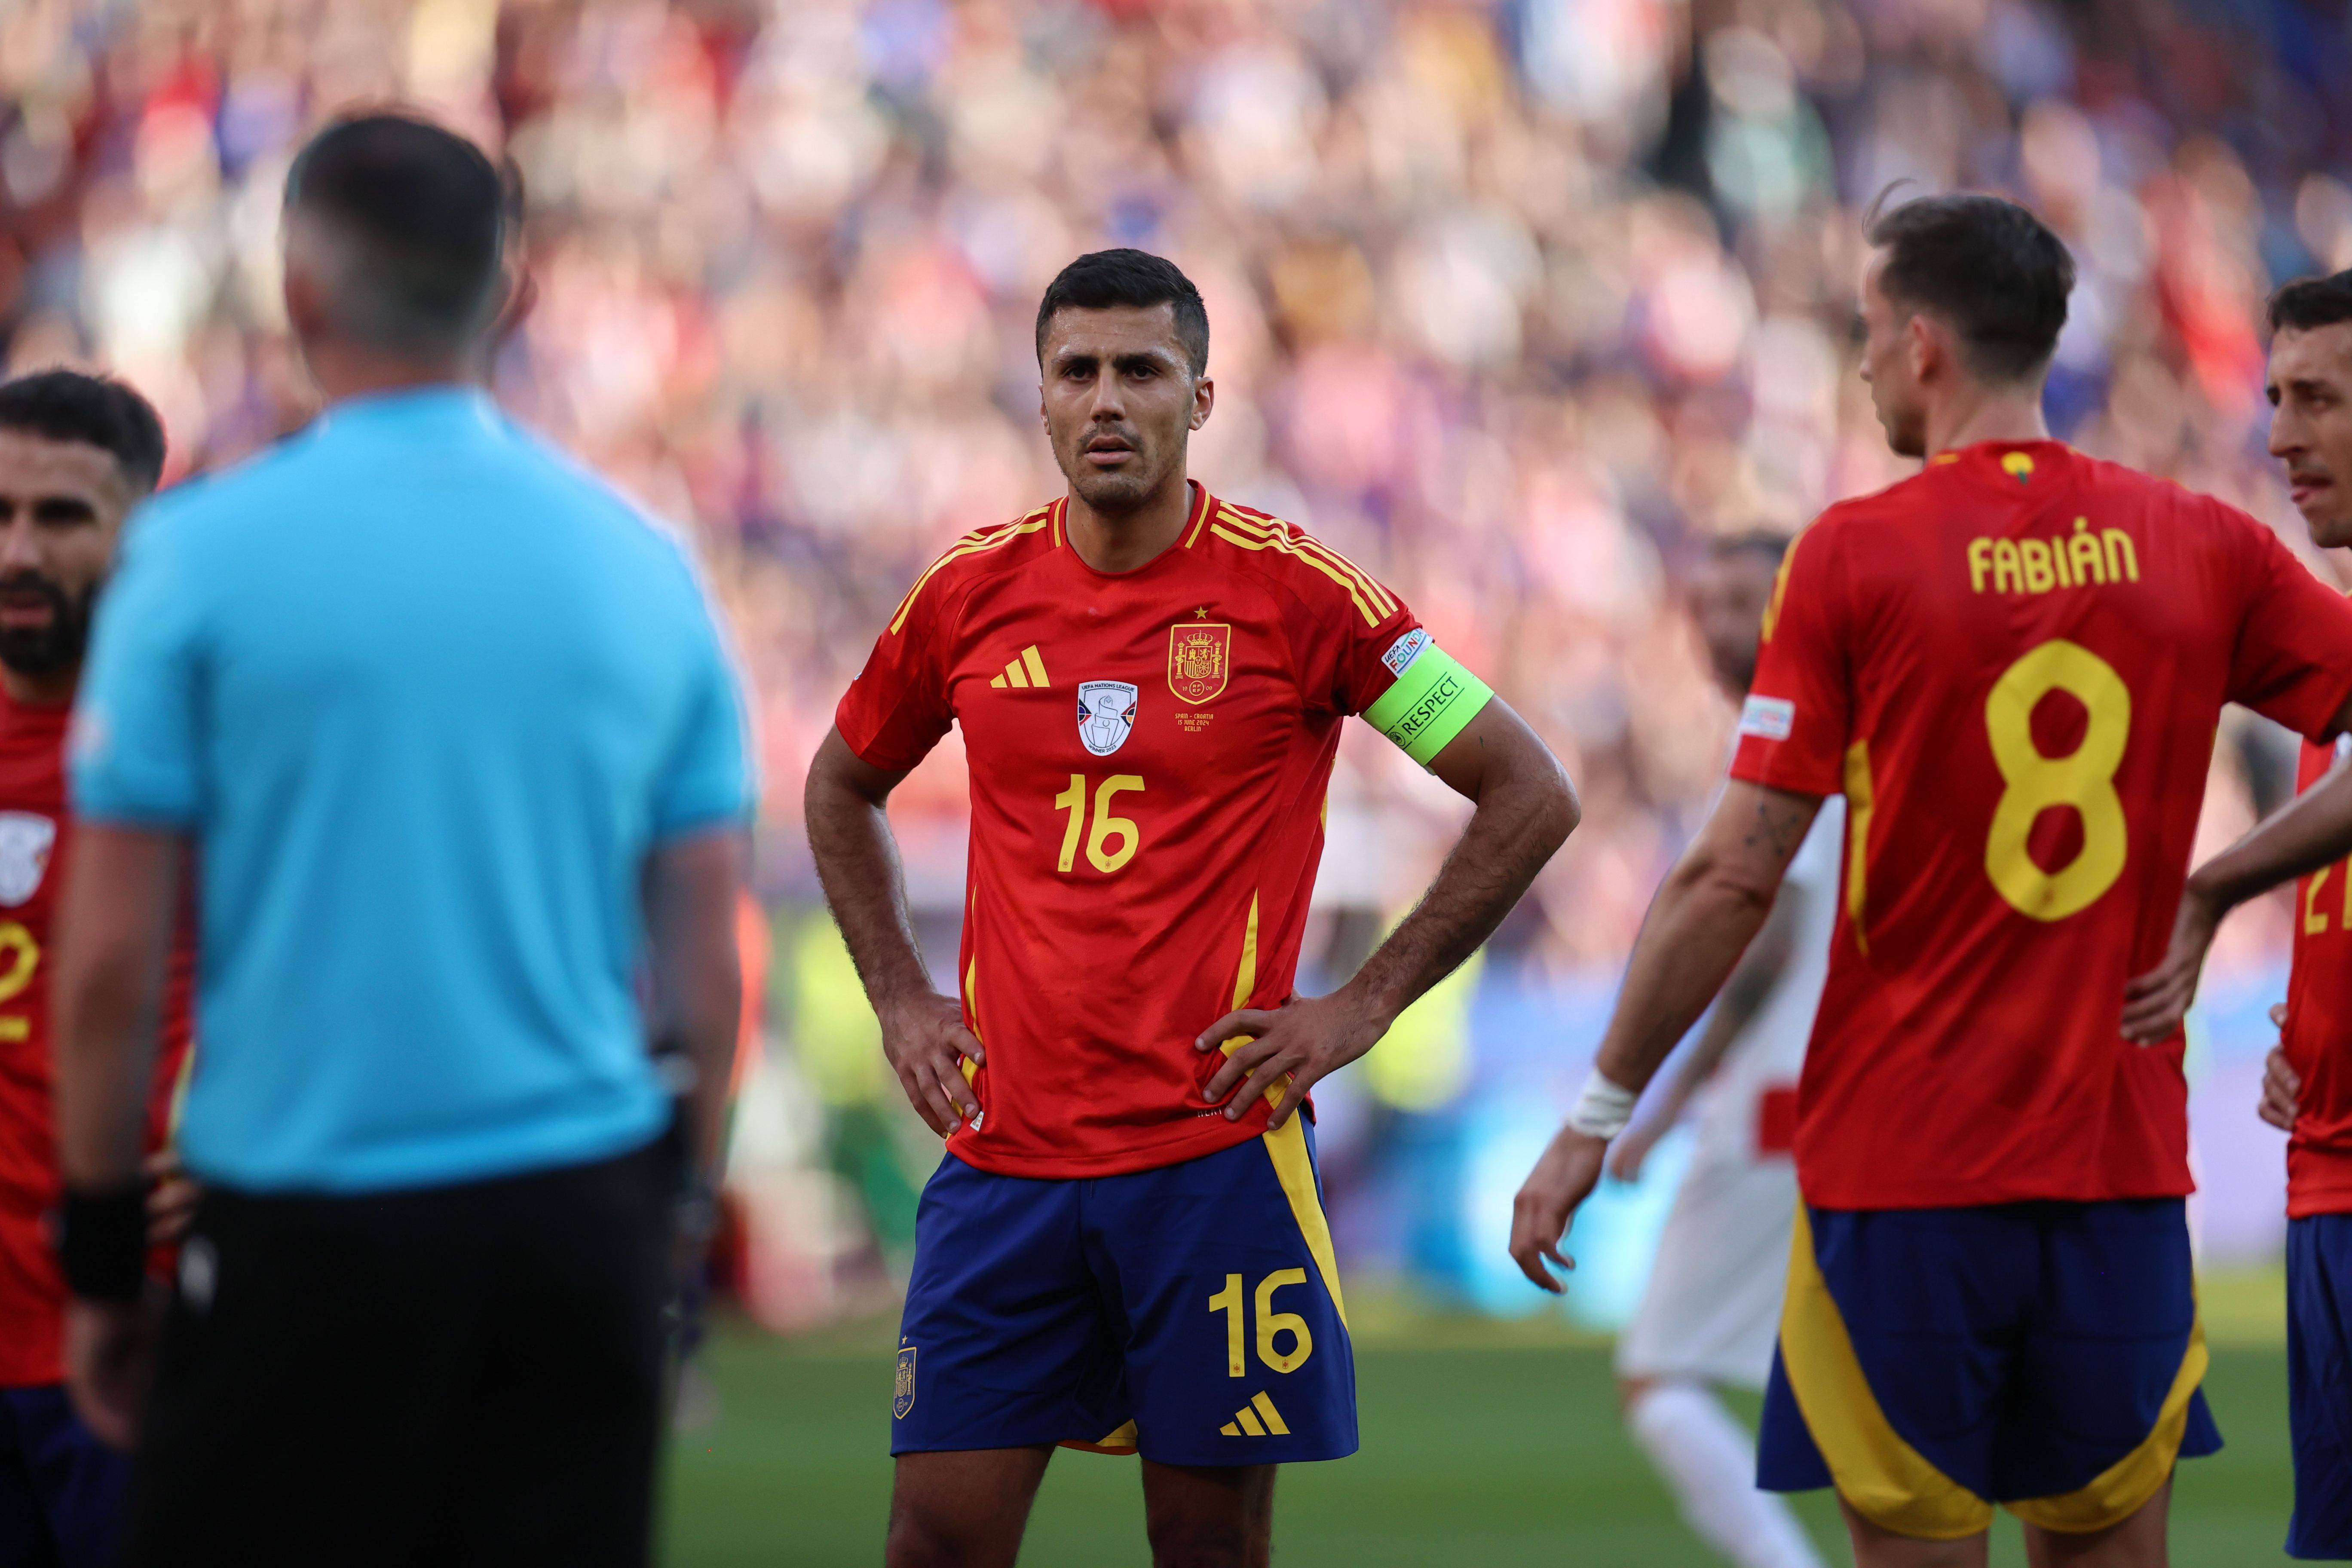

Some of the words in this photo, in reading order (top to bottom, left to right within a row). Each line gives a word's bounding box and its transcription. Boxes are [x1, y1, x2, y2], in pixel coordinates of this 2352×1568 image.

[1967, 517, 2139, 594] FABIÁN
[1384, 645, 1401, 663] UEFA
[1402, 676, 1458, 735] RESPECT
[1089, 744, 1105, 753] WINNER
[1984, 638, 2131, 922] 8
[1055, 774, 1145, 873] 16
[1209, 1268, 1312, 1377] 16
